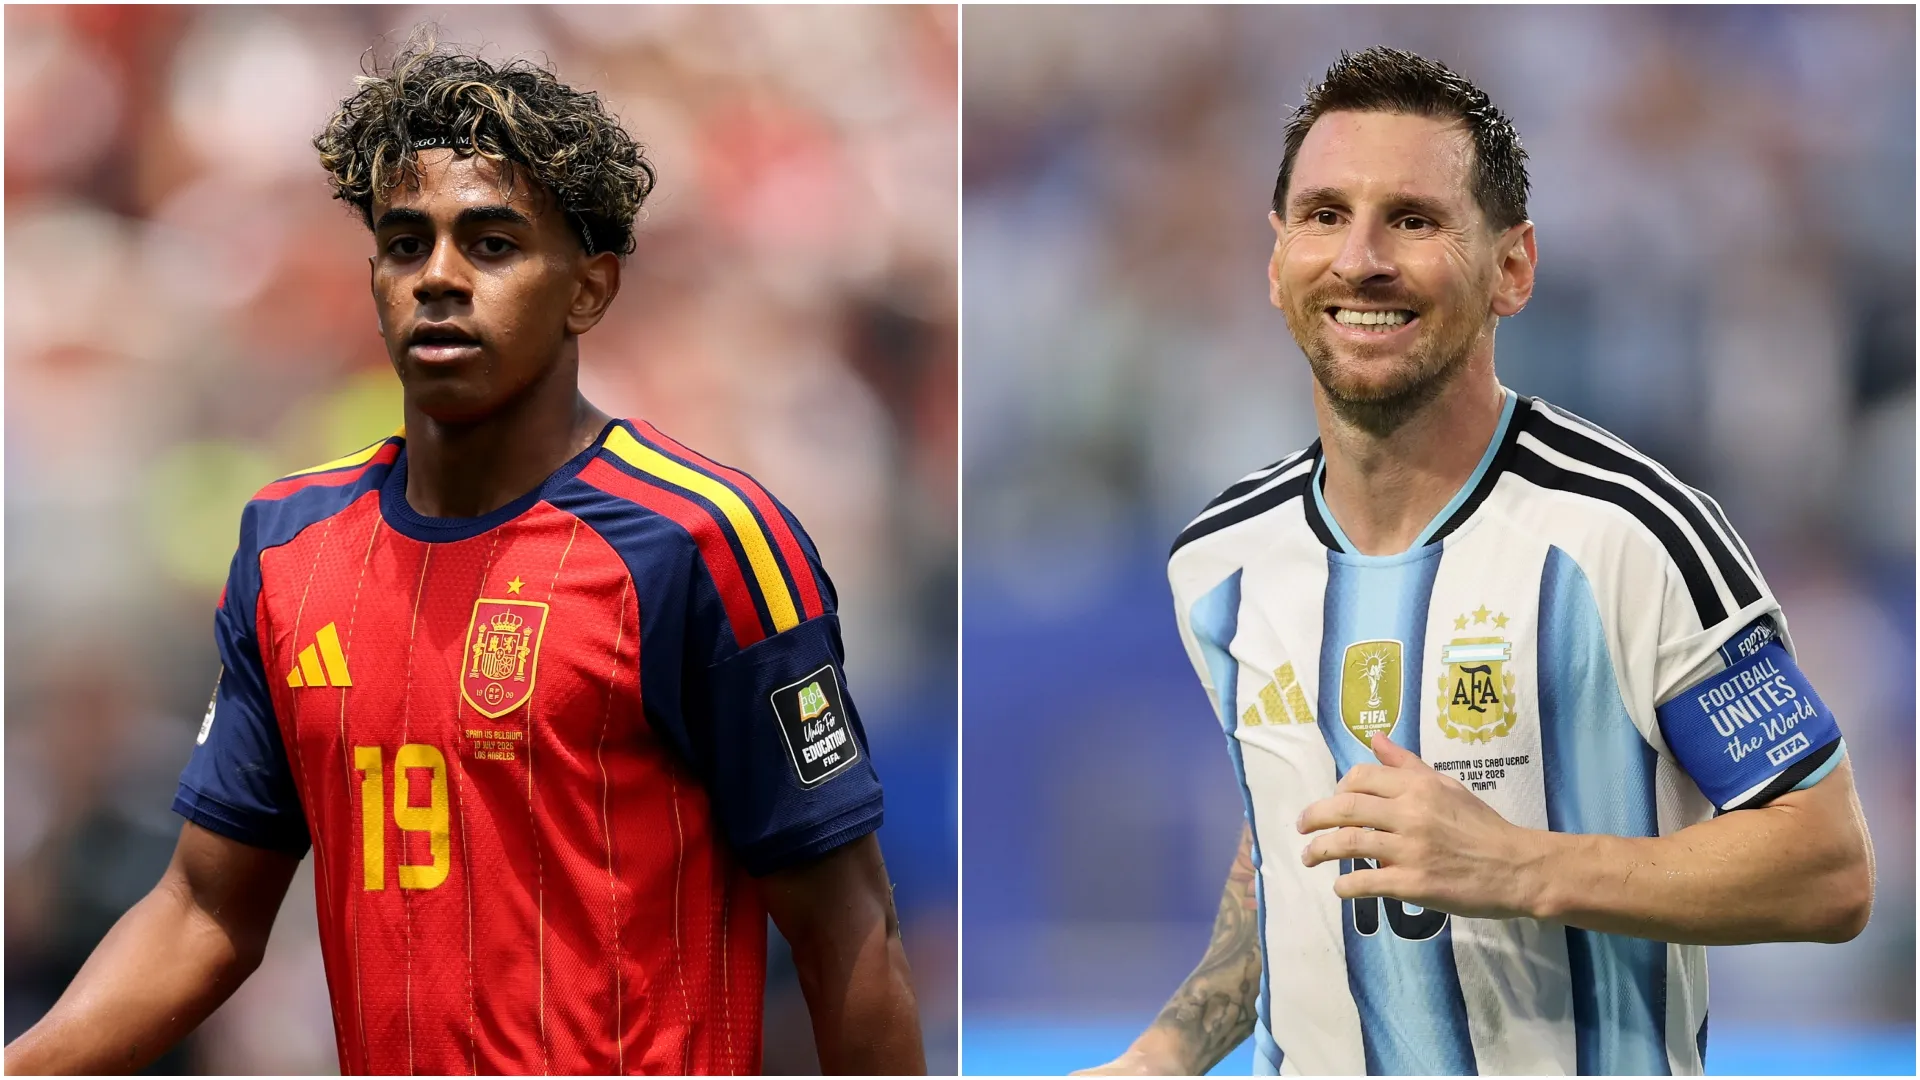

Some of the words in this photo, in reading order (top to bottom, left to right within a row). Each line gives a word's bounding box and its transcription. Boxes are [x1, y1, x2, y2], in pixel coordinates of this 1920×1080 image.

[1452, 664, 1499, 713] AFA
[1698, 657, 1780, 714] FOOTBALL
[1360, 710, 1387, 724] FIFA
[1709, 675, 1797, 738] UNITES
[466, 730, 483, 739] SPAIN
[494, 731, 523, 741] BELGIUM
[803, 719, 825, 743] Unite
[823, 711, 836, 732] For
[1724, 734, 1763, 763] the
[1760, 696, 1818, 742] World
[475, 751, 486, 759] LOS
[487, 752, 515, 761] ANGELES
[483, 741, 496, 750] JULY
[497, 741, 514, 750] 2026
[801, 727, 847, 764] EDUCATION
[1772, 737, 1809, 762] FIFA
[822, 752, 841, 768] FIFA
[1434, 760, 1472, 772] ARGENTINA
[1473, 759, 1483, 769] VS
[1484, 757, 1504, 768] CABO
[1505, 754, 1530, 766] VERDE
[1460, 772, 1465, 781] 3
[1467, 770, 1483, 781] JULY
[1485, 769, 1505, 779] 2026
[1471, 780, 1497, 791] MIAMI
[354, 743, 450, 891] 19
